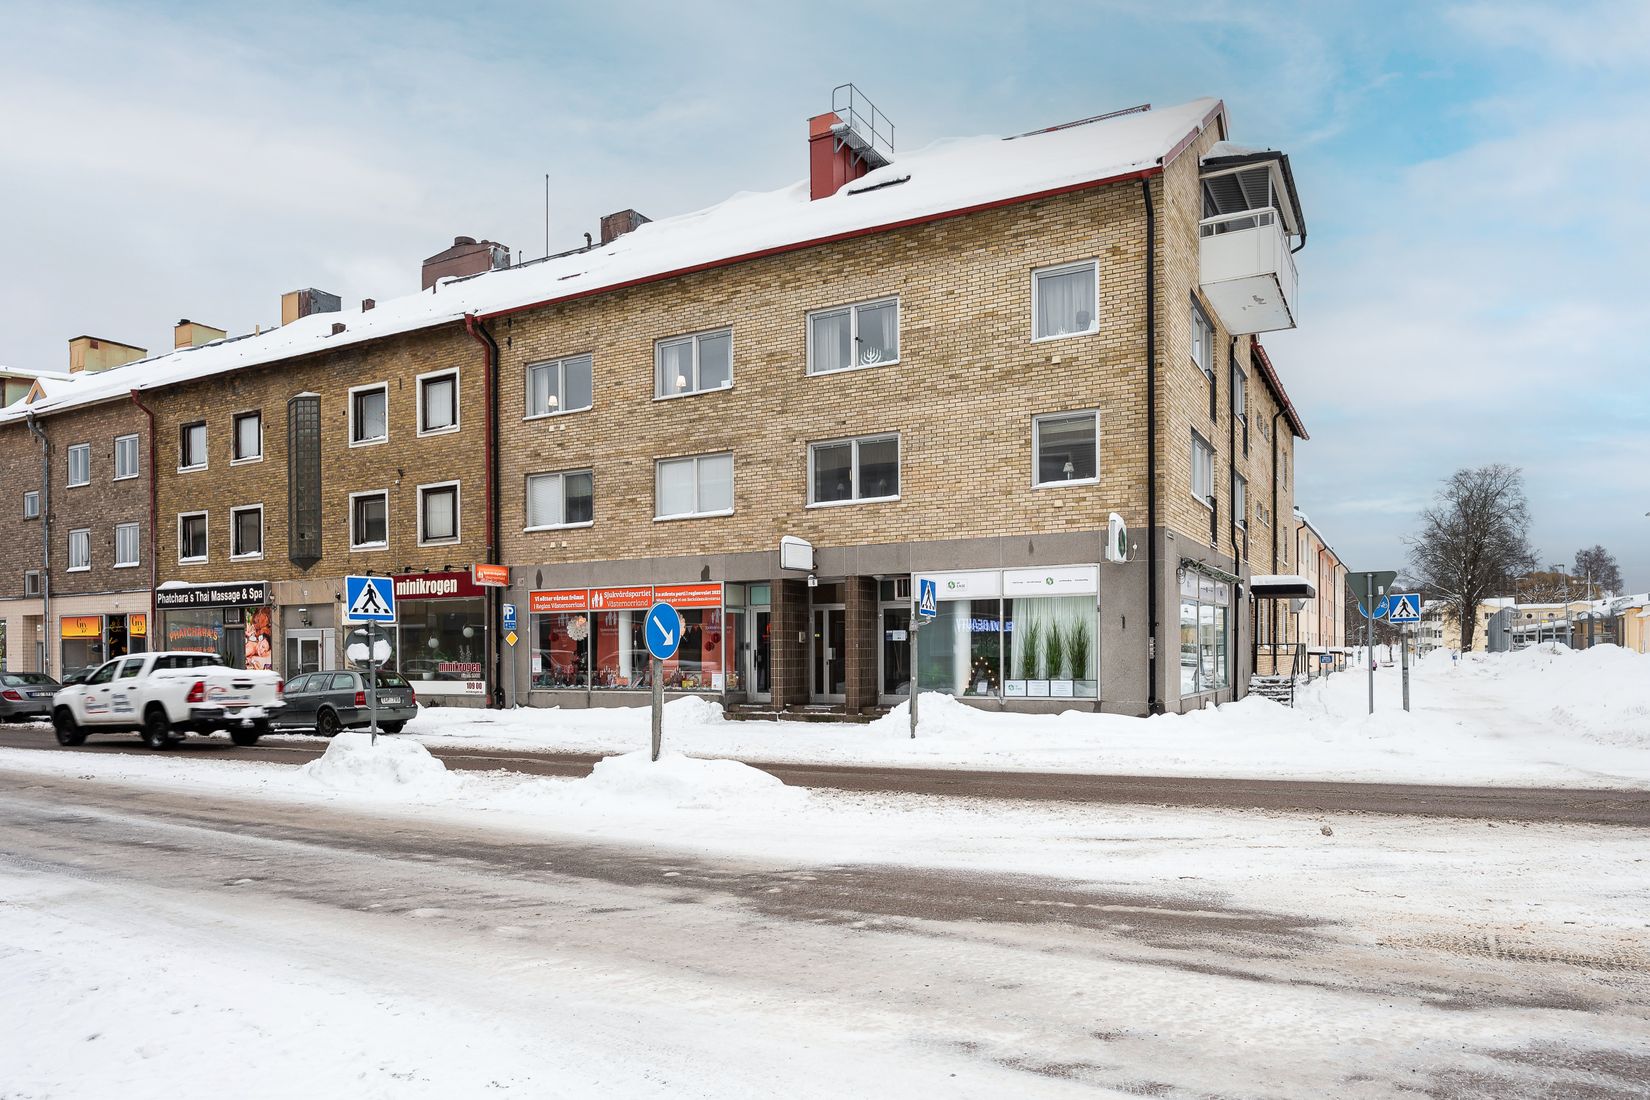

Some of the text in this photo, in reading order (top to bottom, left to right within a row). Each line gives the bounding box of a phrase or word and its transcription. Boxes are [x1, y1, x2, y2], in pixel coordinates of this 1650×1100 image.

[396, 578, 458, 596] minikrogen
[195, 591, 210, 602] Thai
[211, 590, 240, 603] Massage
[241, 588, 247, 600] &
[249, 587, 263, 602] Spa
[603, 590, 652, 599] Sjukvårdspartiet
[506, 606, 514, 620] P
[438, 662, 481, 673] minikrogen
